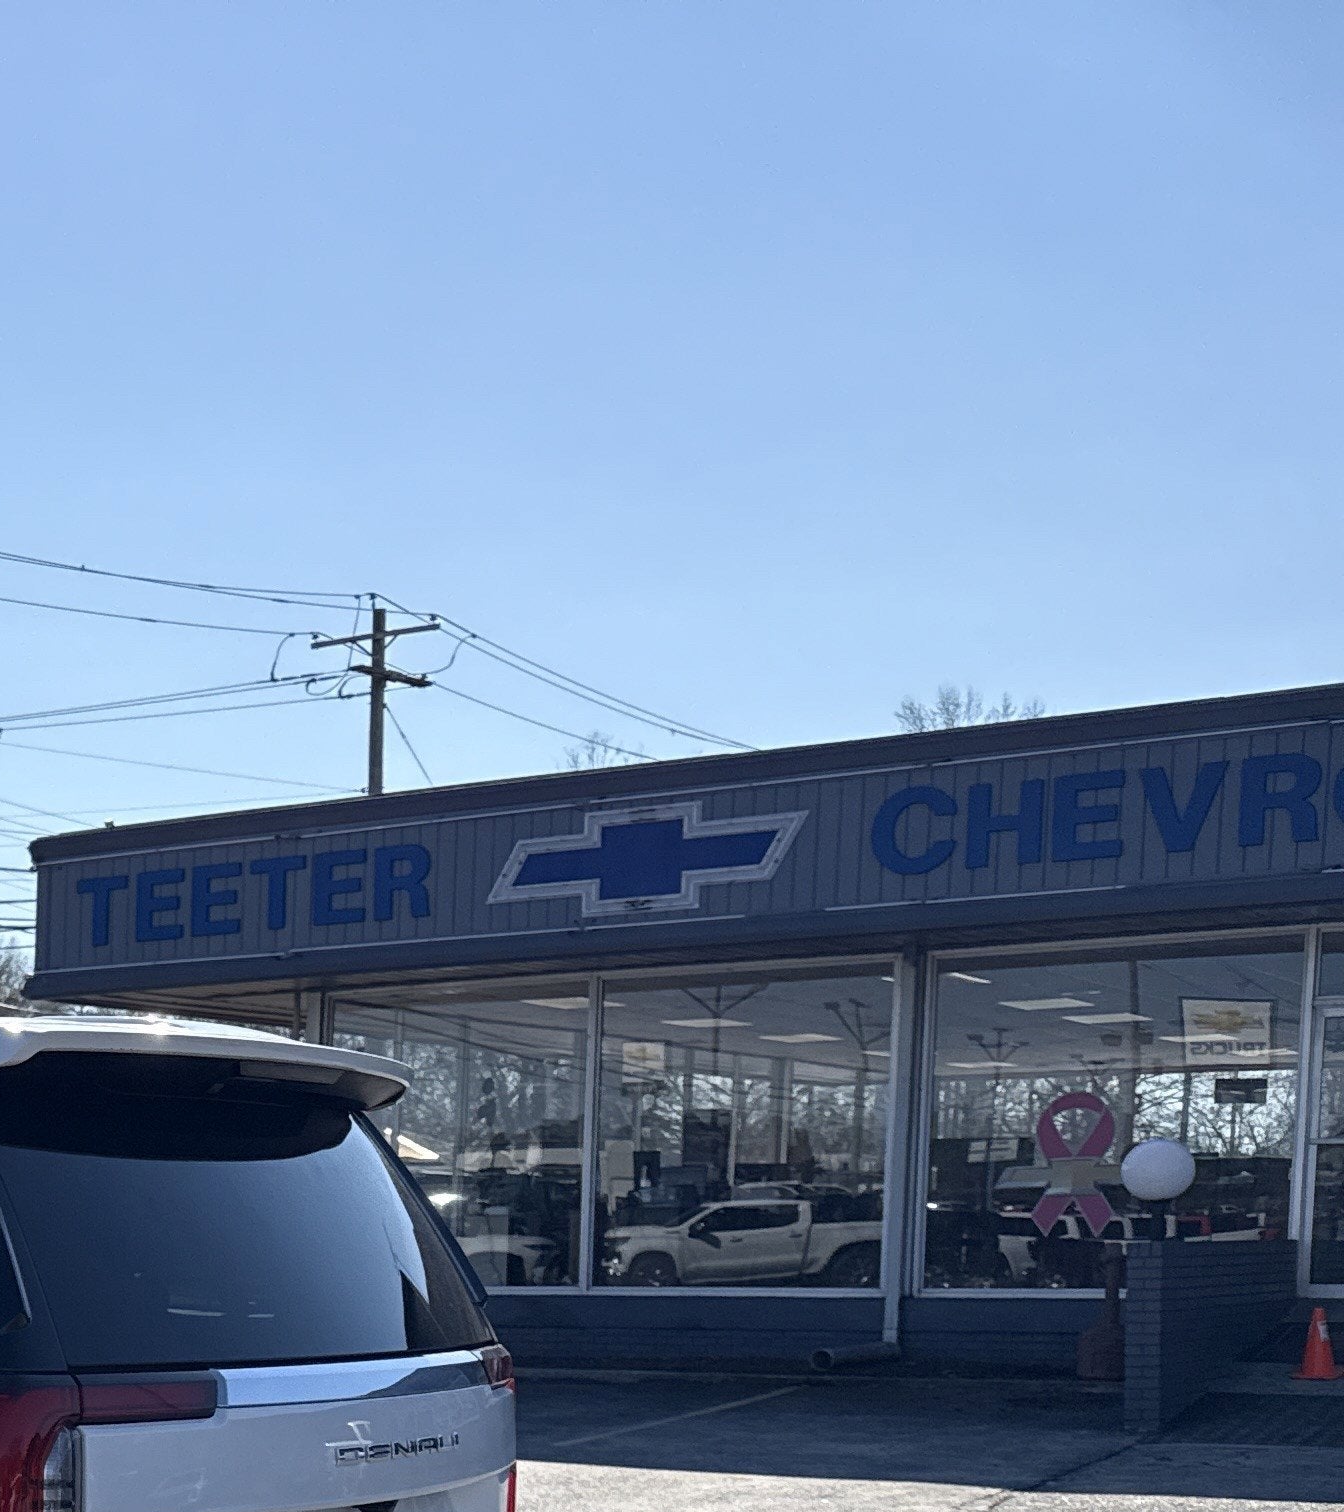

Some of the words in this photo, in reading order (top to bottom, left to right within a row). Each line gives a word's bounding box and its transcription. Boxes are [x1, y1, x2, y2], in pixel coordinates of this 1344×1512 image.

[76, 843, 433, 948] TEETER
[870, 751, 1344, 876] CHEVR
[334, 1433, 459, 1466] DENALI
